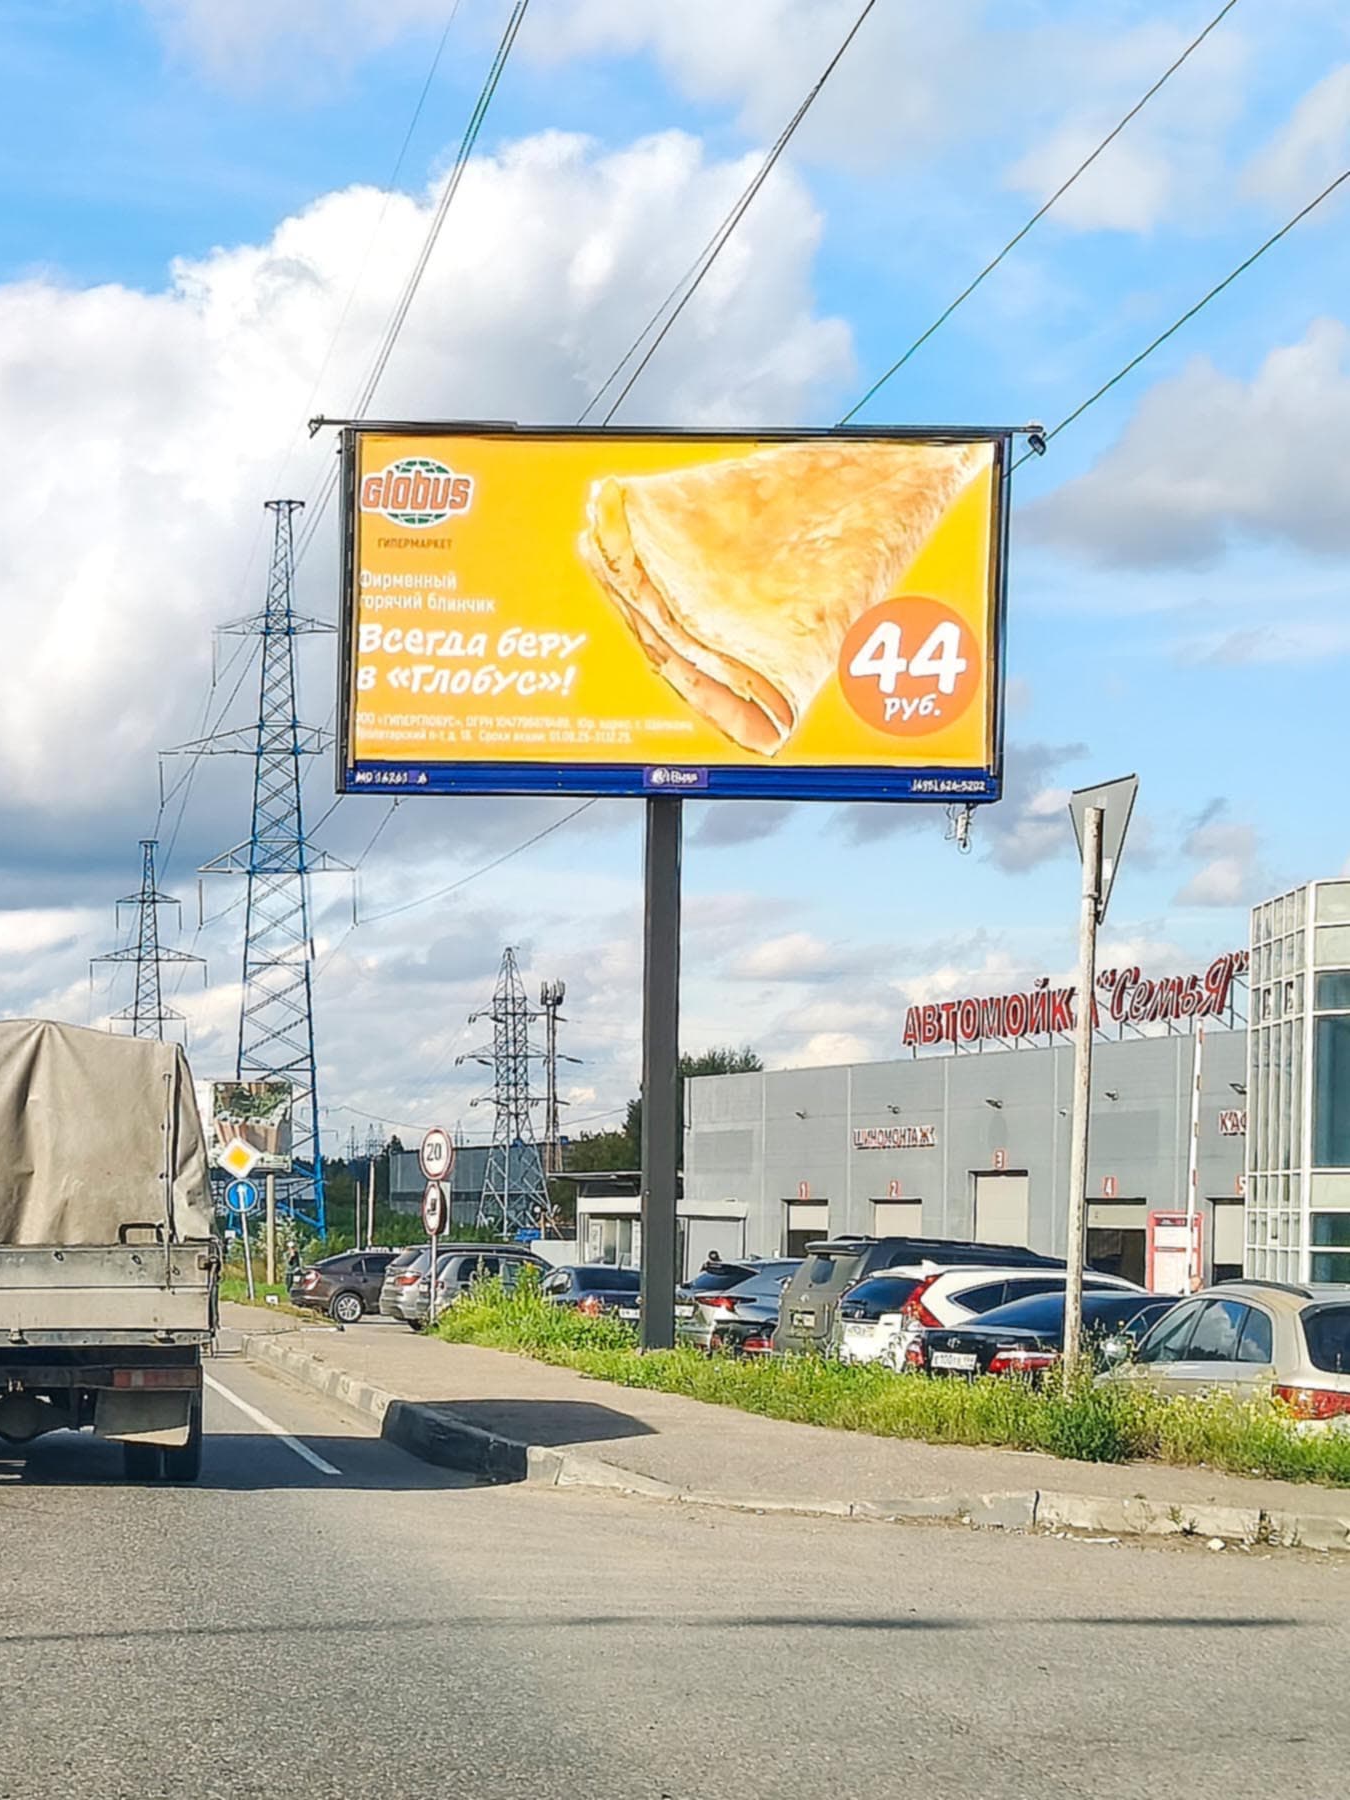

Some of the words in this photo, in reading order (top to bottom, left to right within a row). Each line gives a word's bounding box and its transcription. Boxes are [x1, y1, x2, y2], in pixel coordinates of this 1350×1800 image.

[377, 538, 453, 549] ГИПЕРМАРКЕТ
[427, 592, 495, 612] блинчик
[359, 623, 487, 658] Всегда
[497, 626, 587, 659] беру
[850, 620, 968, 695] 44
[357, 665, 378, 690] в
[883, 693, 942, 721] руб.
[853, 1126, 936, 1148] ШИНОМОНТАЖ
[426, 1142, 443, 1161] 20
[995, 1151, 1005, 1168] 3
[890, 1181, 899, 1198] 2
[1103, 1176, 1116, 1196] 4
